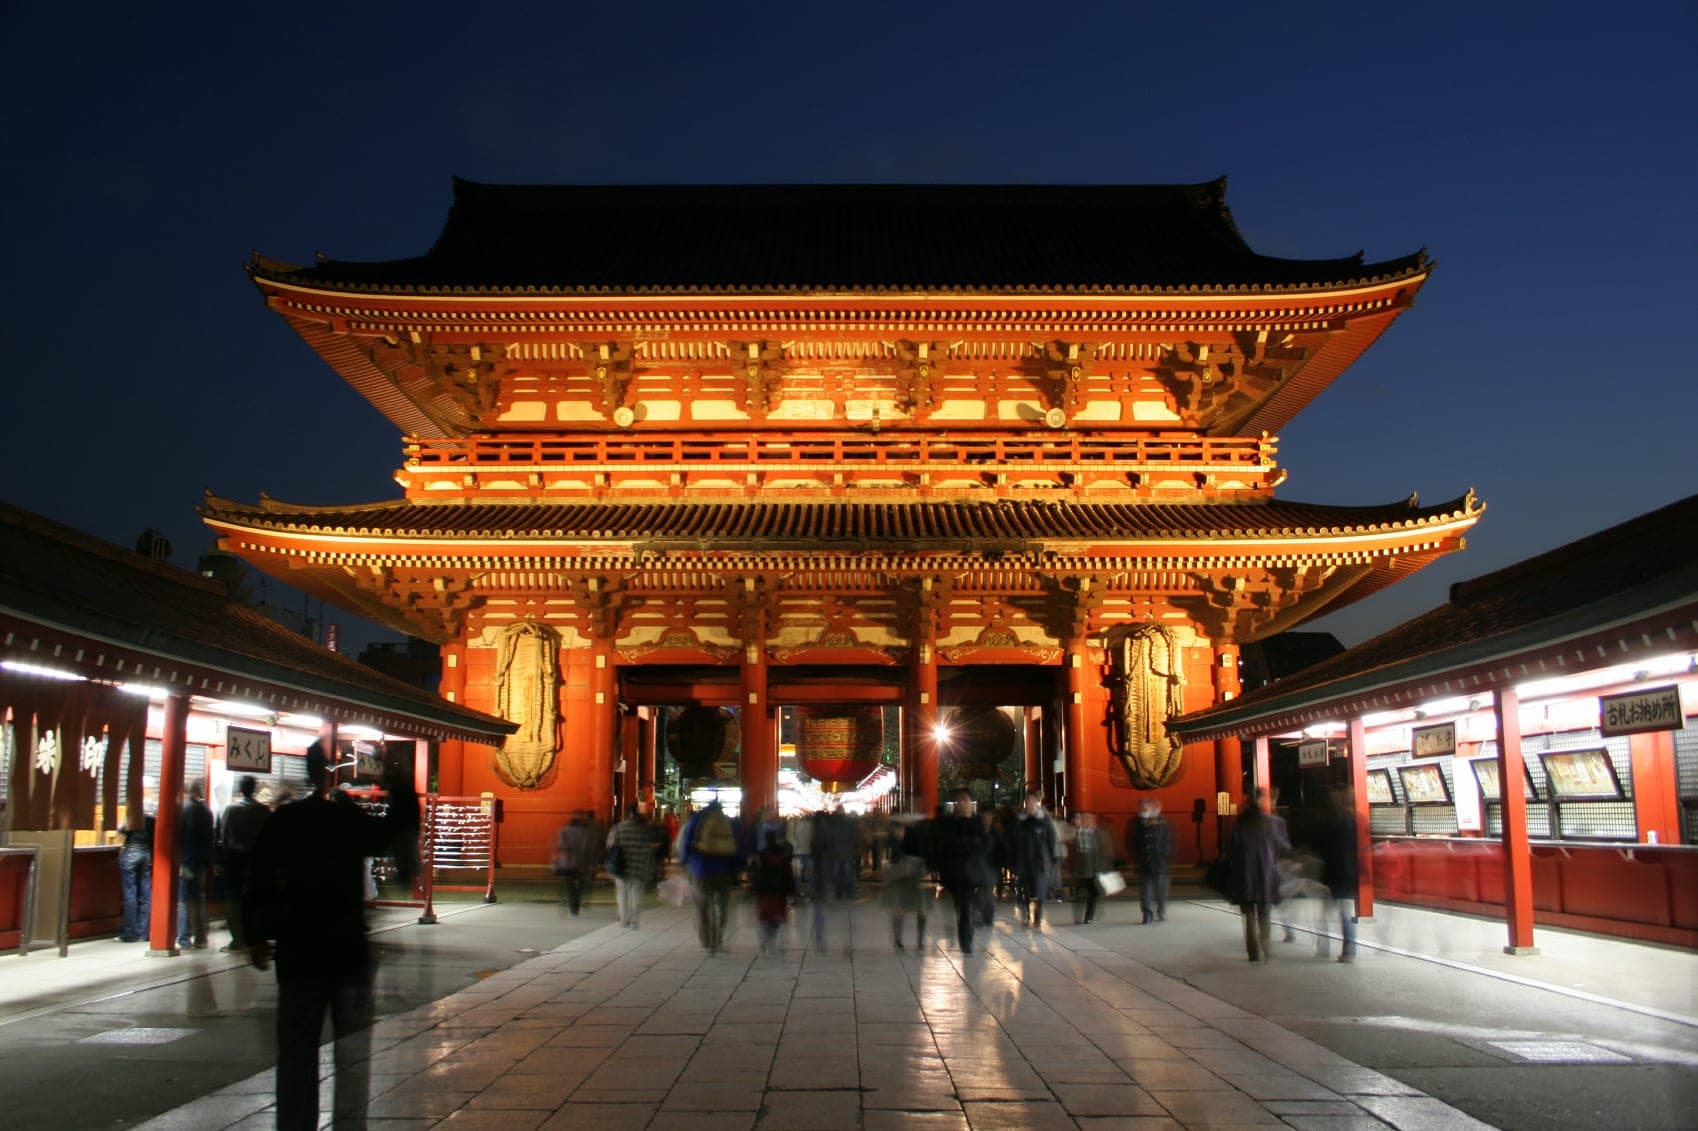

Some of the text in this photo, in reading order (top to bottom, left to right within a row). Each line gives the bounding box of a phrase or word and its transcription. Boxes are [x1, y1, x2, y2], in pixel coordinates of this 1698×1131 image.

[1607, 696, 1675, 726] 古札お納め所
[230, 736, 266, 760] みくじ
